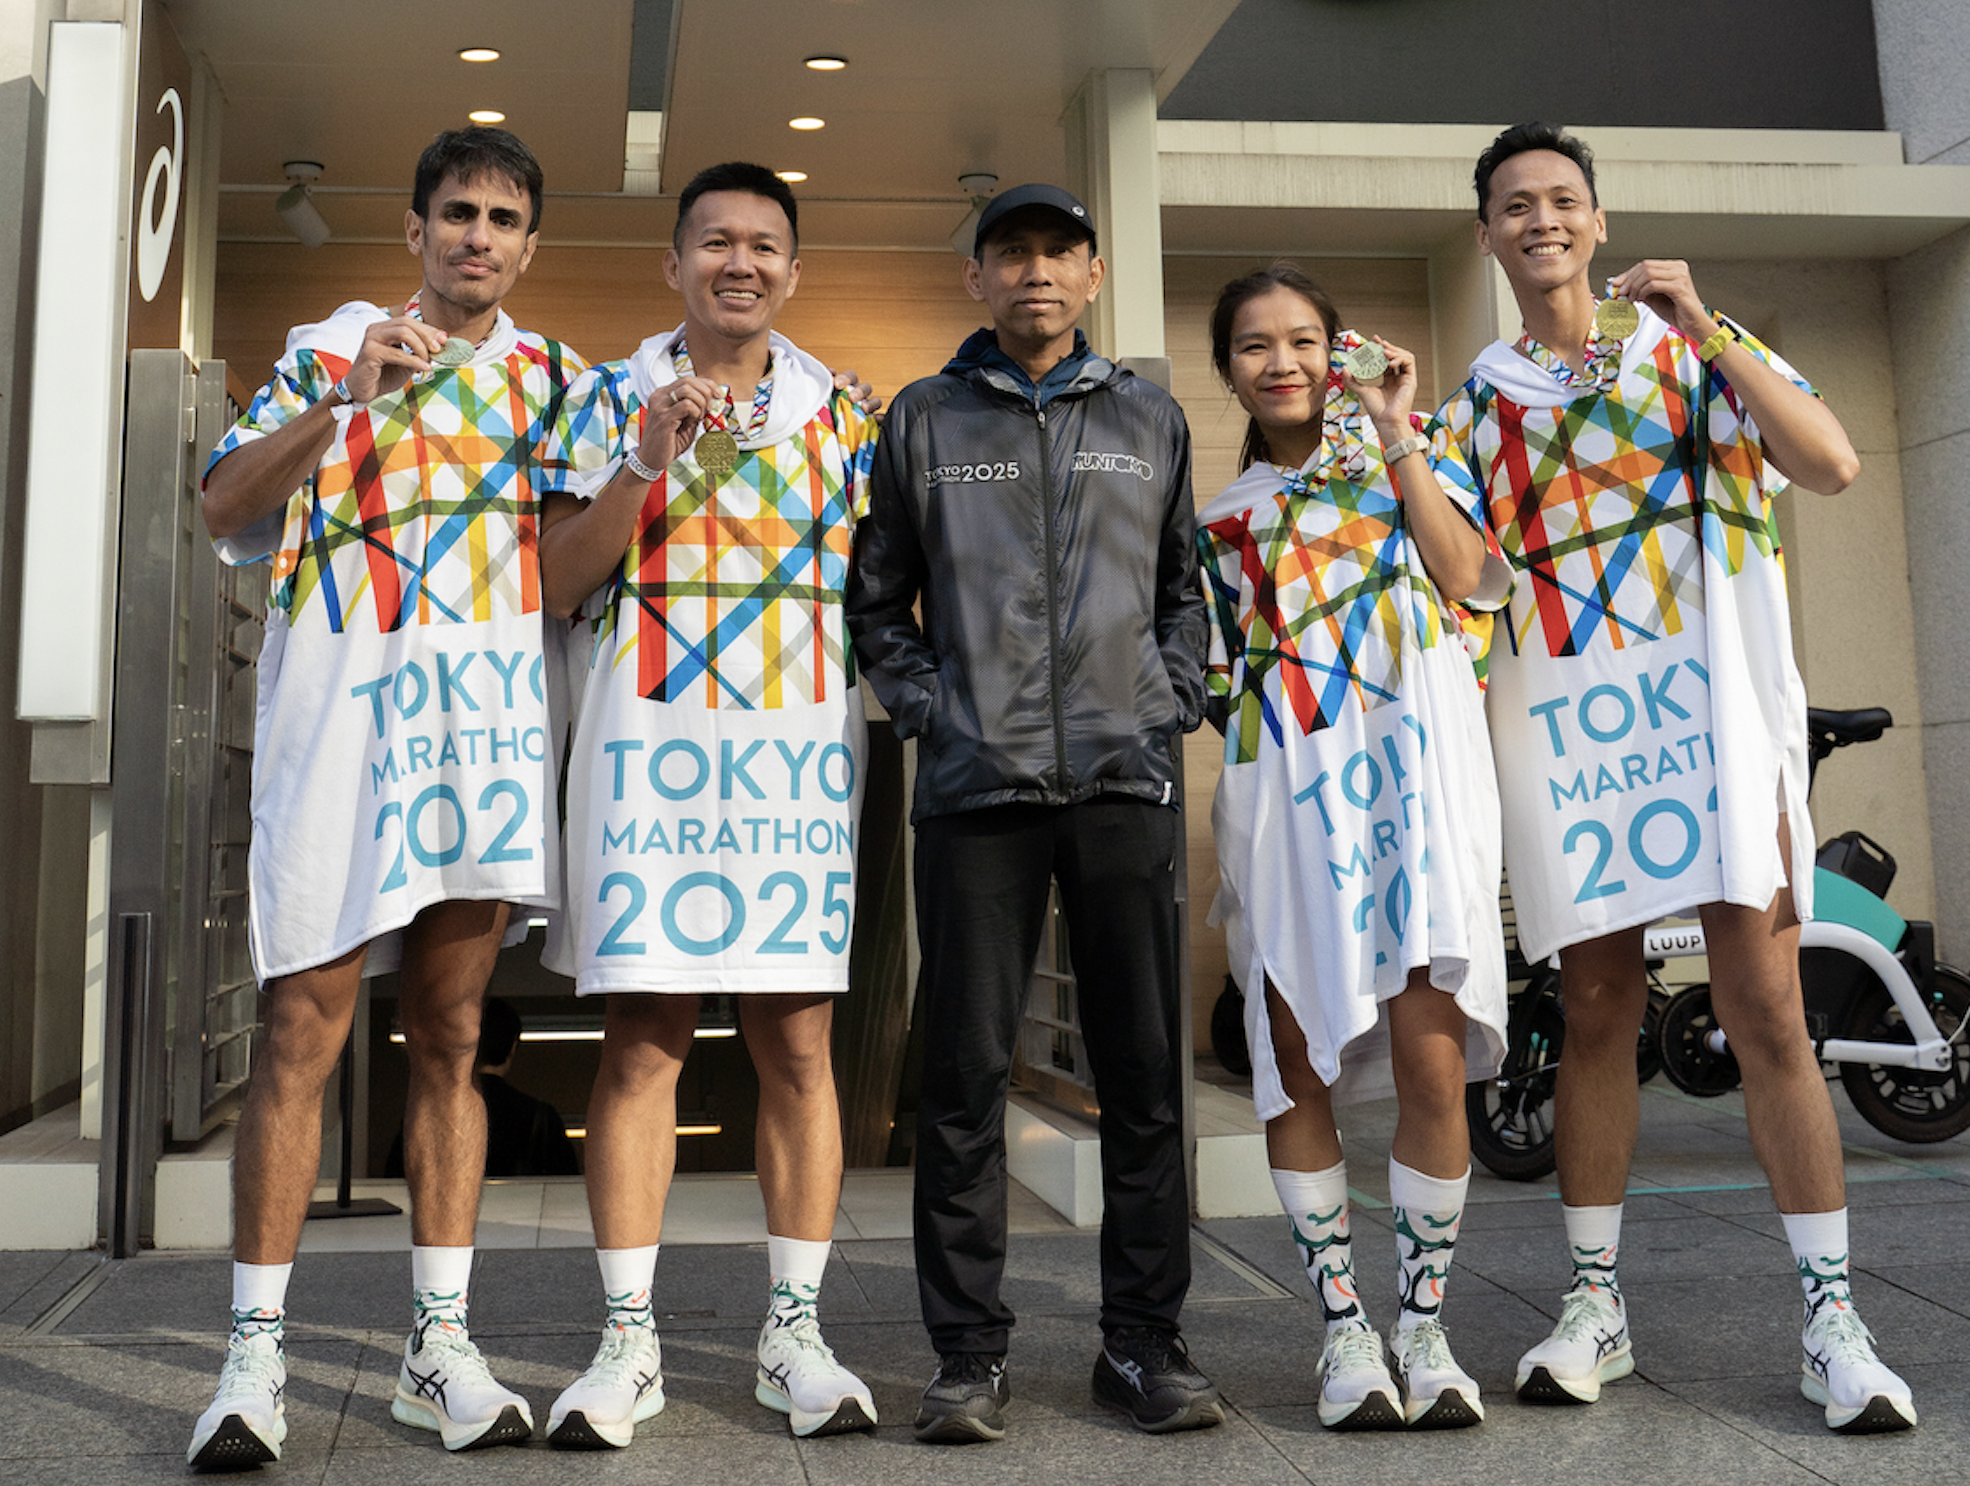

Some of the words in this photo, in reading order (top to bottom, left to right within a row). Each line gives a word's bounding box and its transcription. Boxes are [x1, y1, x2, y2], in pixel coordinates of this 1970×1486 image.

[961, 461, 1020, 483] 2025
[371, 727, 545, 796] MRATHO
[604, 739, 855, 803] TOKYO
[374, 779, 545, 894] 202
[602, 818, 853, 856] MARATHON
[1562, 784, 1722, 904] 20
[595, 870, 851, 957] 2025
[1649, 935, 1701, 951] LUUP
